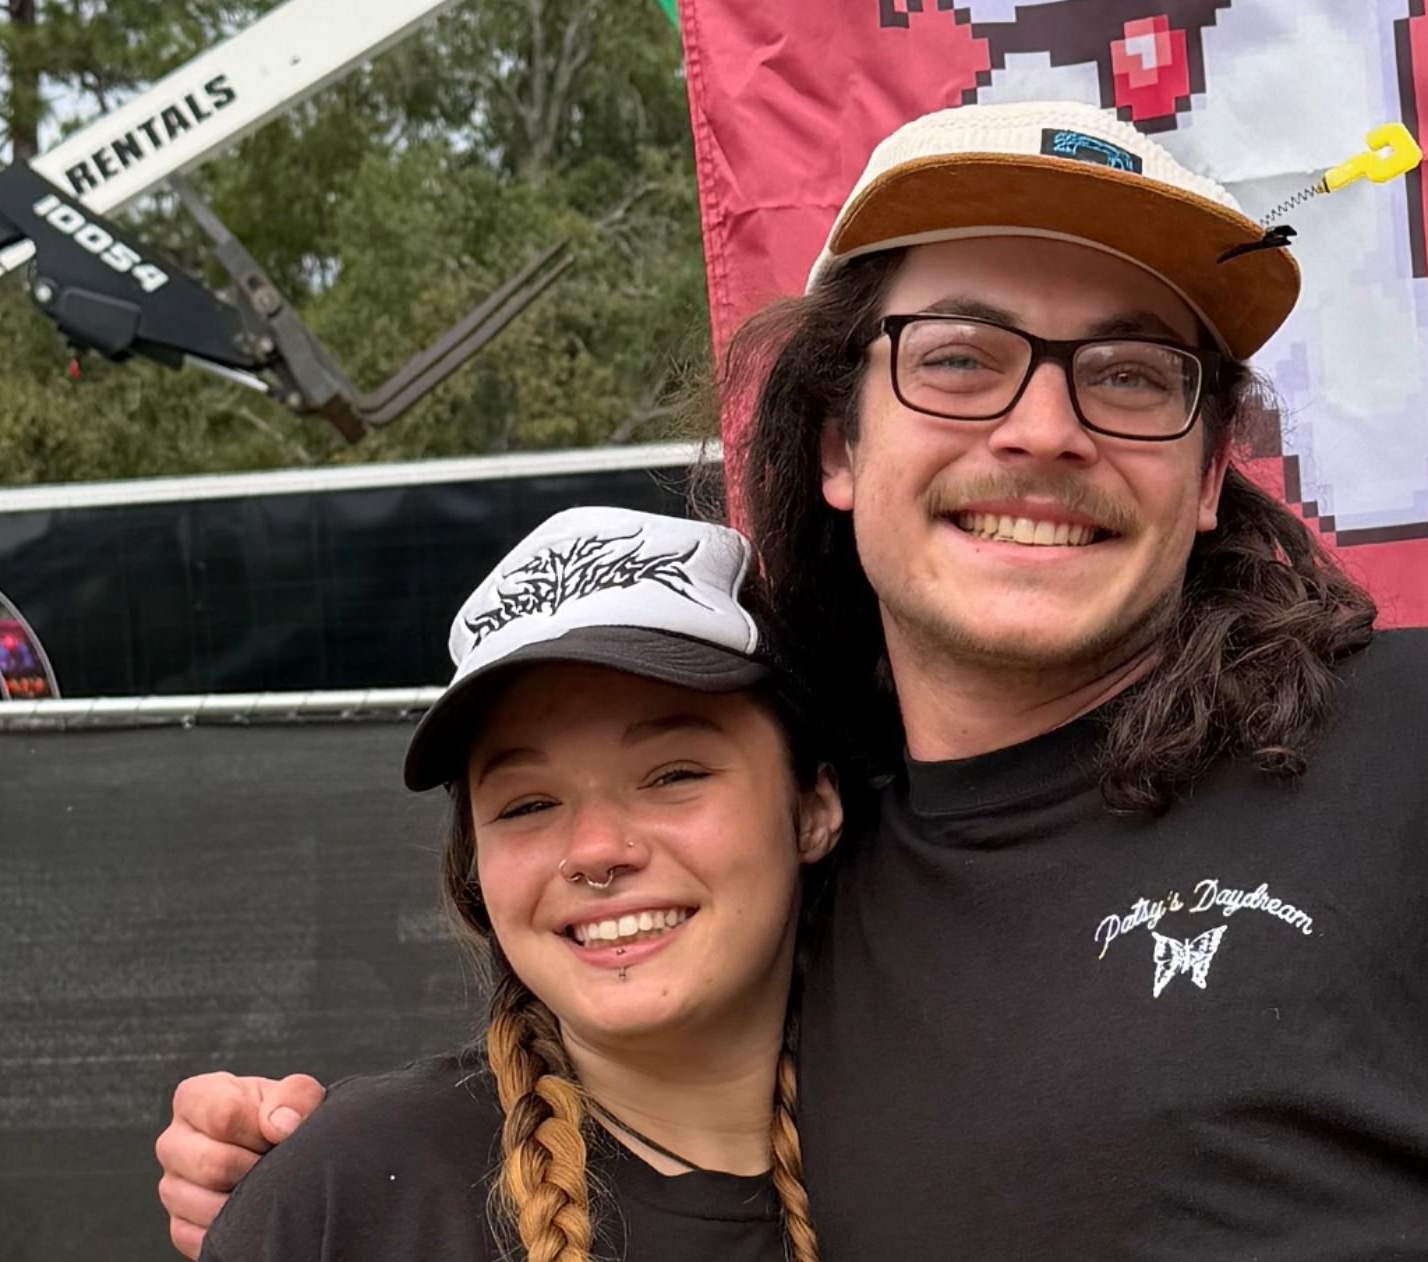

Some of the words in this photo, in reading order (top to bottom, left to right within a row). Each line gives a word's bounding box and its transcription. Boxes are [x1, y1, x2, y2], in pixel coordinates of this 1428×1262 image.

[65, 74, 237, 195] RENTALS
[33, 194, 170, 293] 10054
[1094, 890, 1184, 960] Patsy's
[1189, 879, 1313, 935] Daydream
